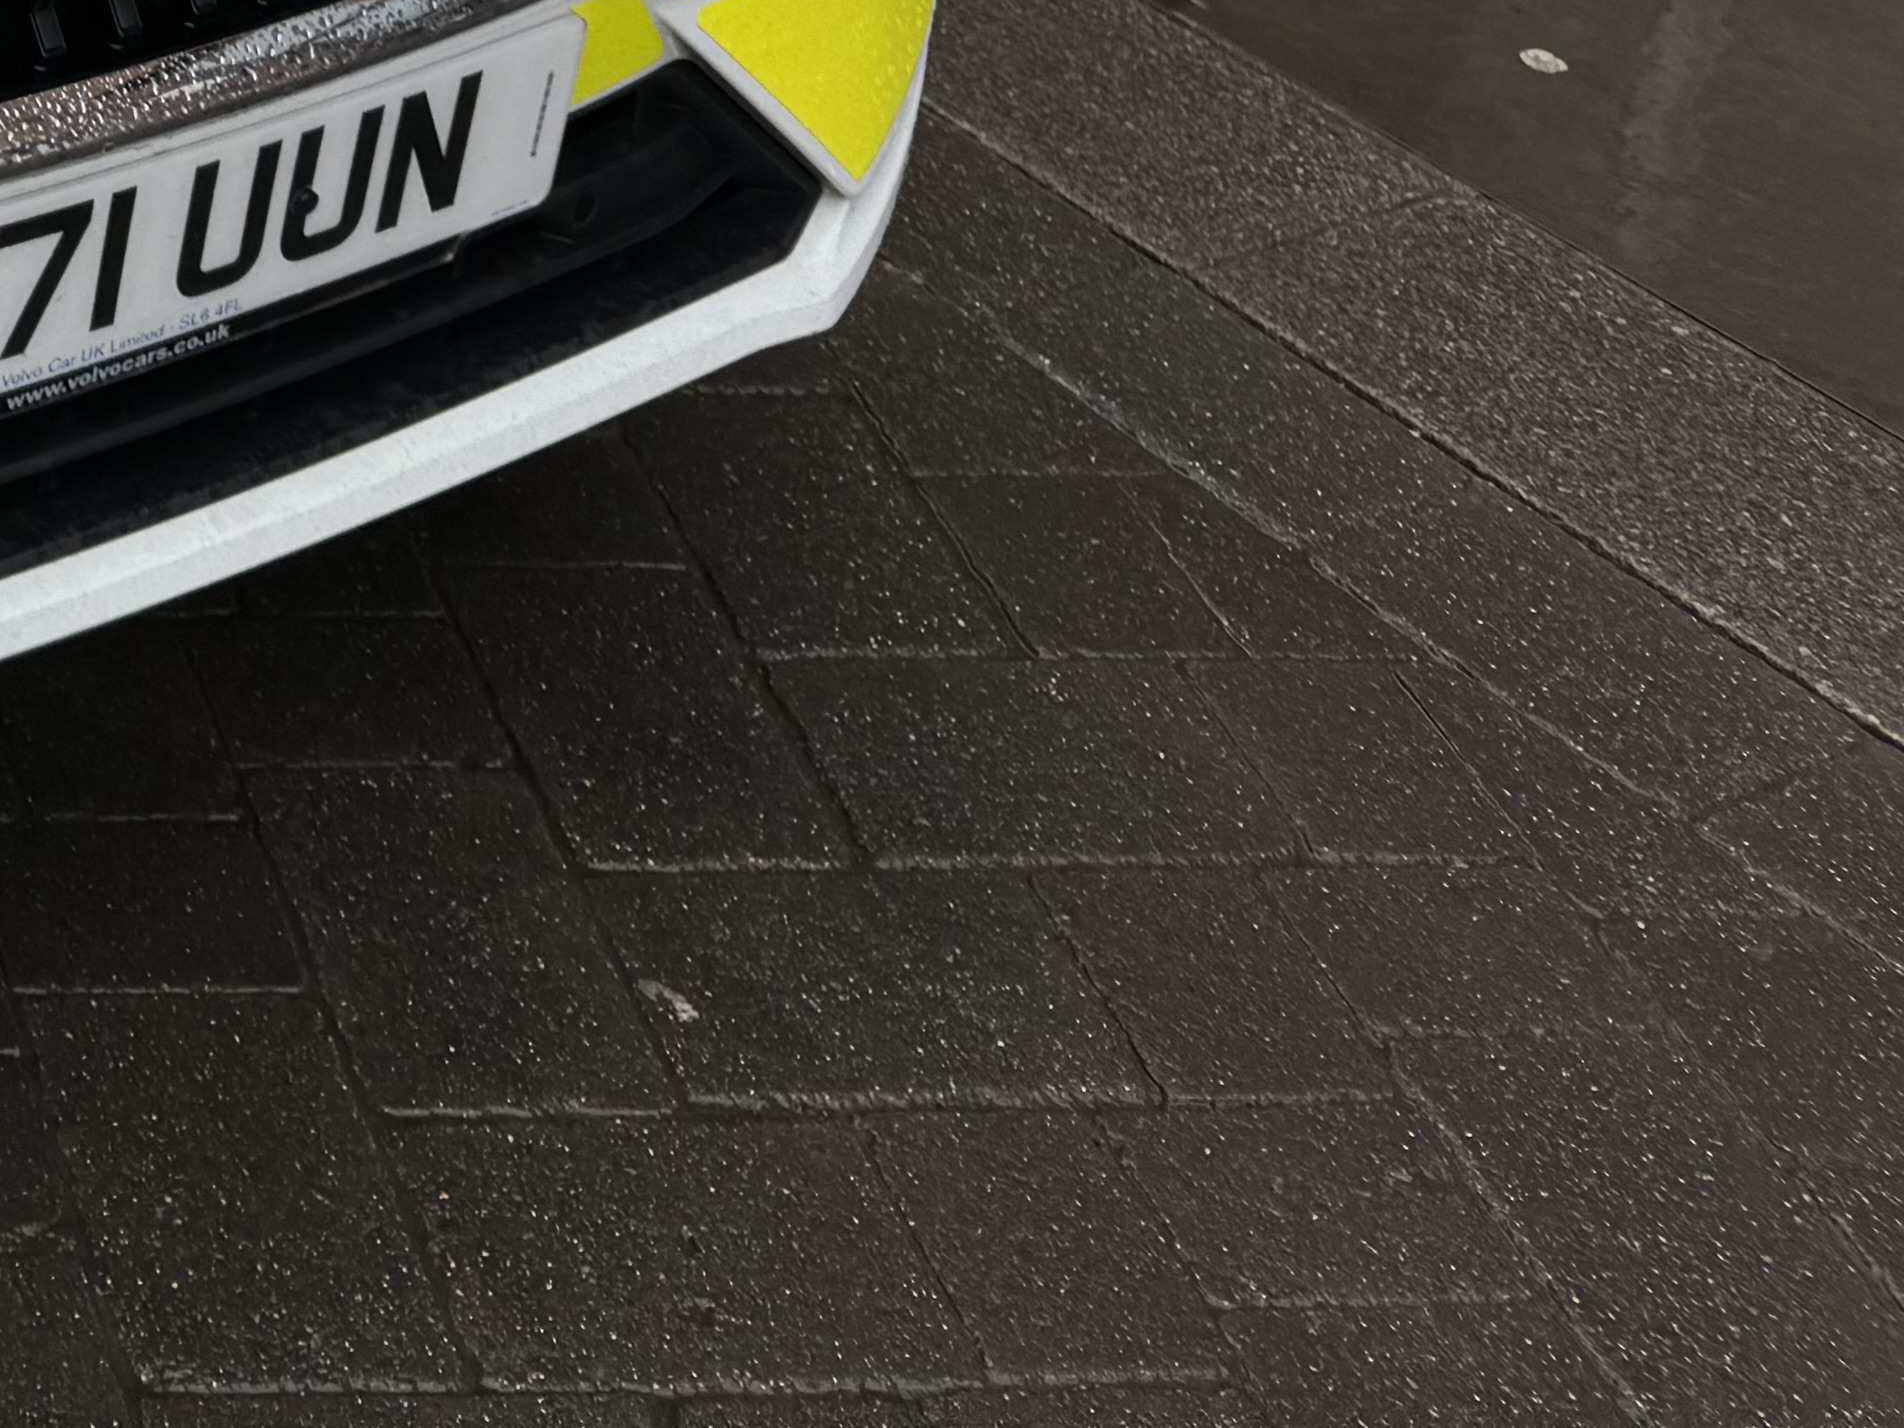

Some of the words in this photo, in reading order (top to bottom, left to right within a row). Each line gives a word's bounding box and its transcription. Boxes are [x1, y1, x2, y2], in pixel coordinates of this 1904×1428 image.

[176, 70, 483, 298] UUN
[2, 366, 42, 388] Volvo
[48, 355, 77, 374] Car
[81, 343, 107, 362] UK
[110, 322, 166, 354] Limited
[179, 309, 210, 331] SL6
[214, 296, 242, 318] 4FL
[6, 322, 231, 411] www.volvocars.co.uk
